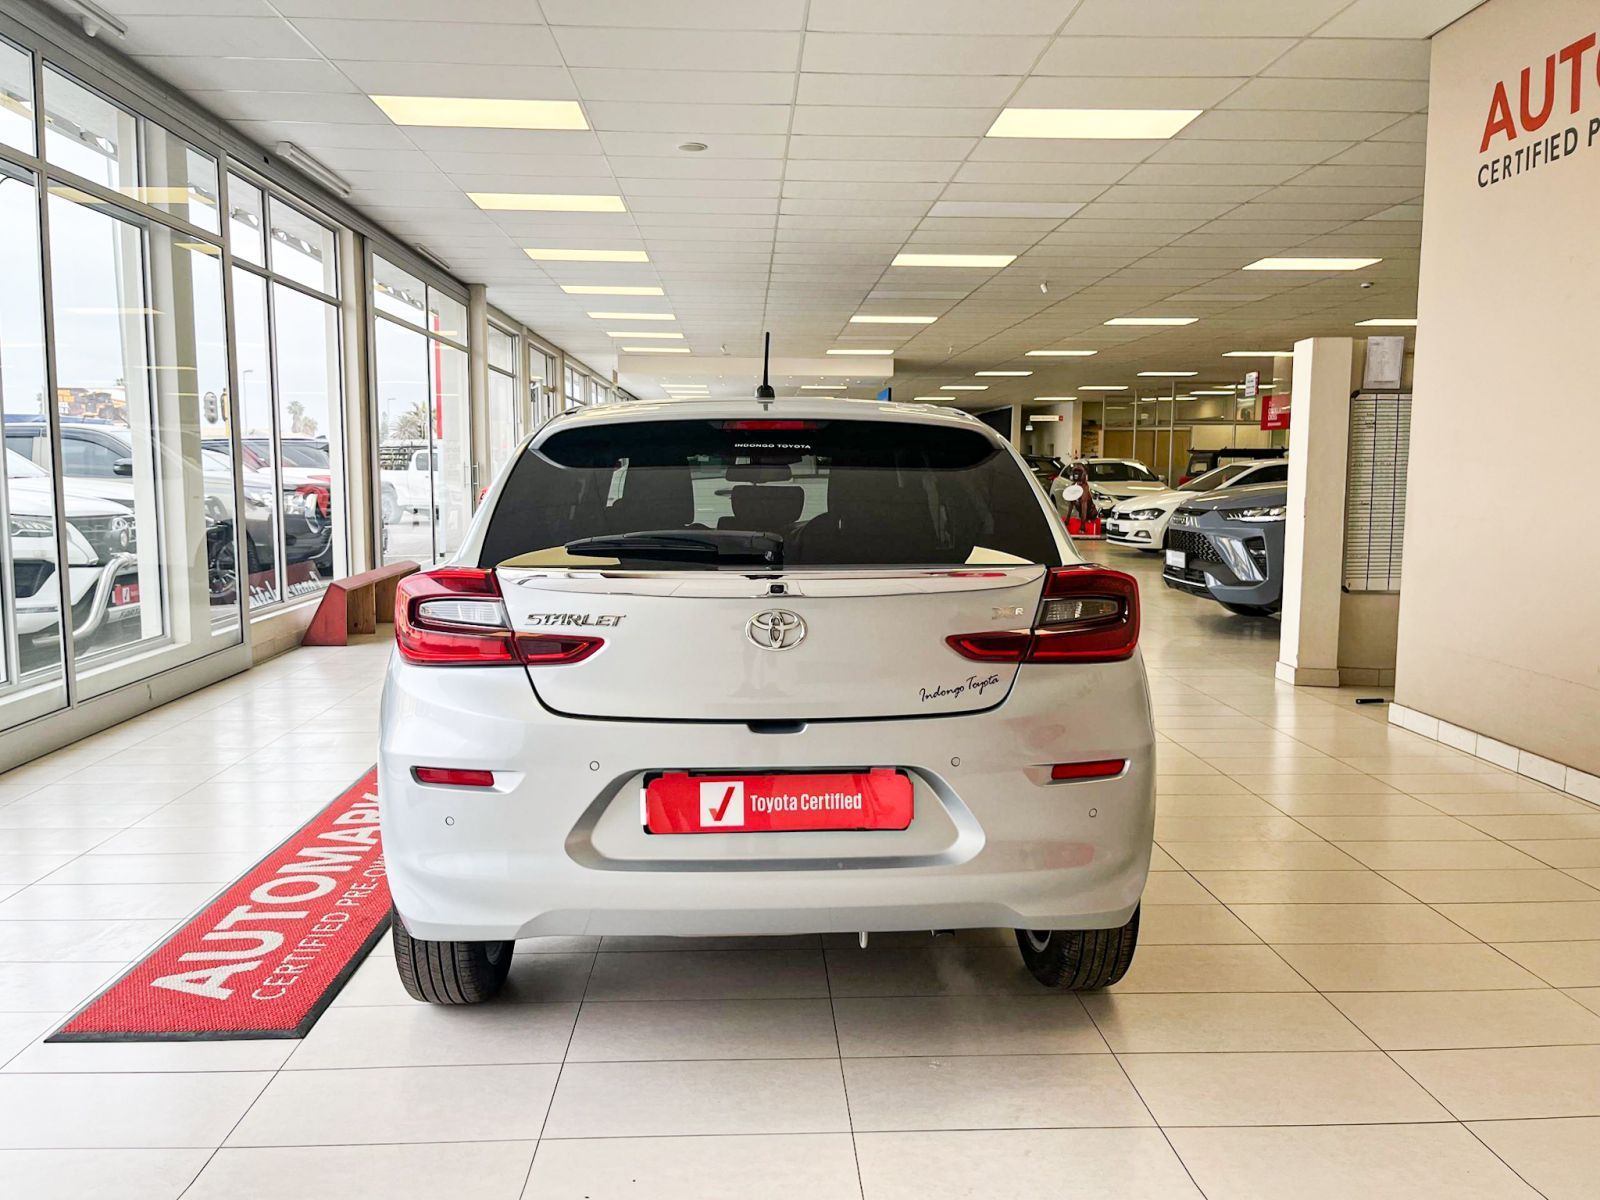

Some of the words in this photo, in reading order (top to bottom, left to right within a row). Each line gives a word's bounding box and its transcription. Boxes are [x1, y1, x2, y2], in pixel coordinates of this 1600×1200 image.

[1479, 32, 1600, 154] AUT
[1478, 127, 1578, 188] CERTIFIED
[524, 613, 627, 627] STARLET
[919, 684, 965, 702] Indongo
[966, 674, 999, 695] Toyota
[750, 794, 798, 812] Toyota
[800, 793, 862, 810] Certified
[252, 911, 350, 1001] CERTIFIED
